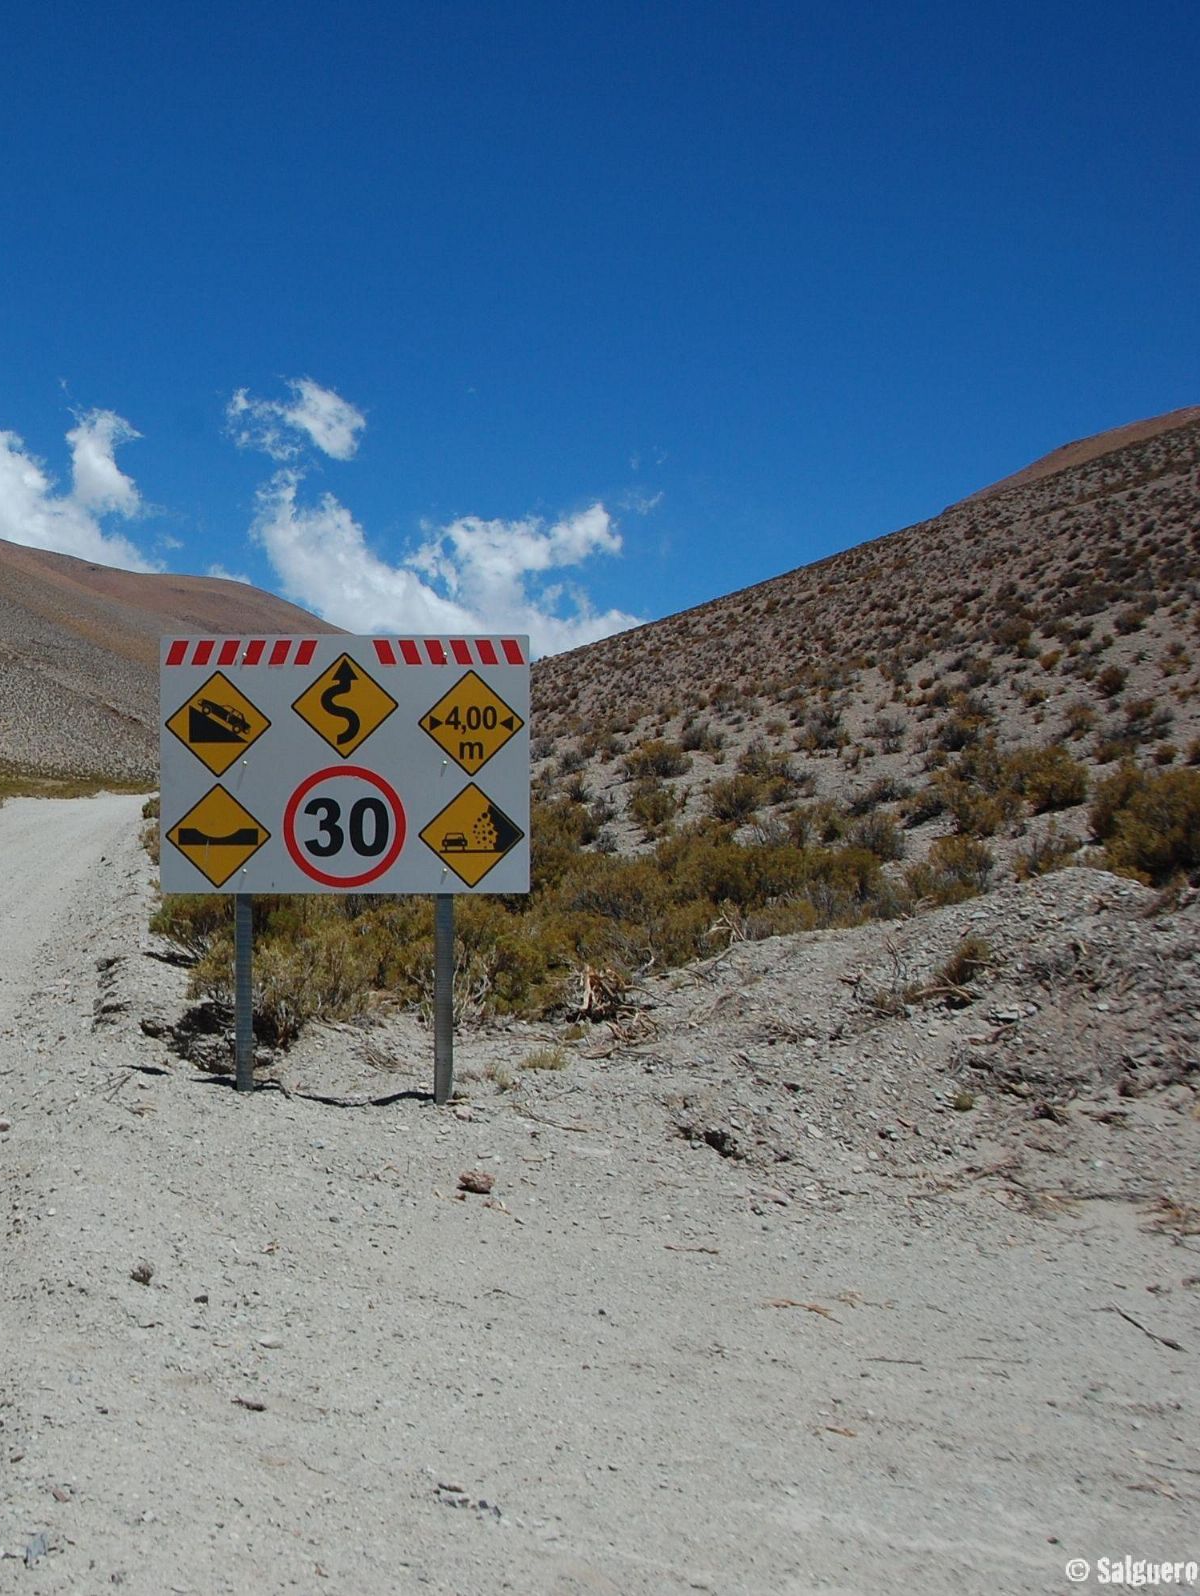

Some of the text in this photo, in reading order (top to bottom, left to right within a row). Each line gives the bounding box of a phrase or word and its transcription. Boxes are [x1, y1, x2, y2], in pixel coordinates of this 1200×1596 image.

[445, 705, 497, 735] 4,00
[459, 741, 484, 760] m
[304, 797, 390, 857] 30
